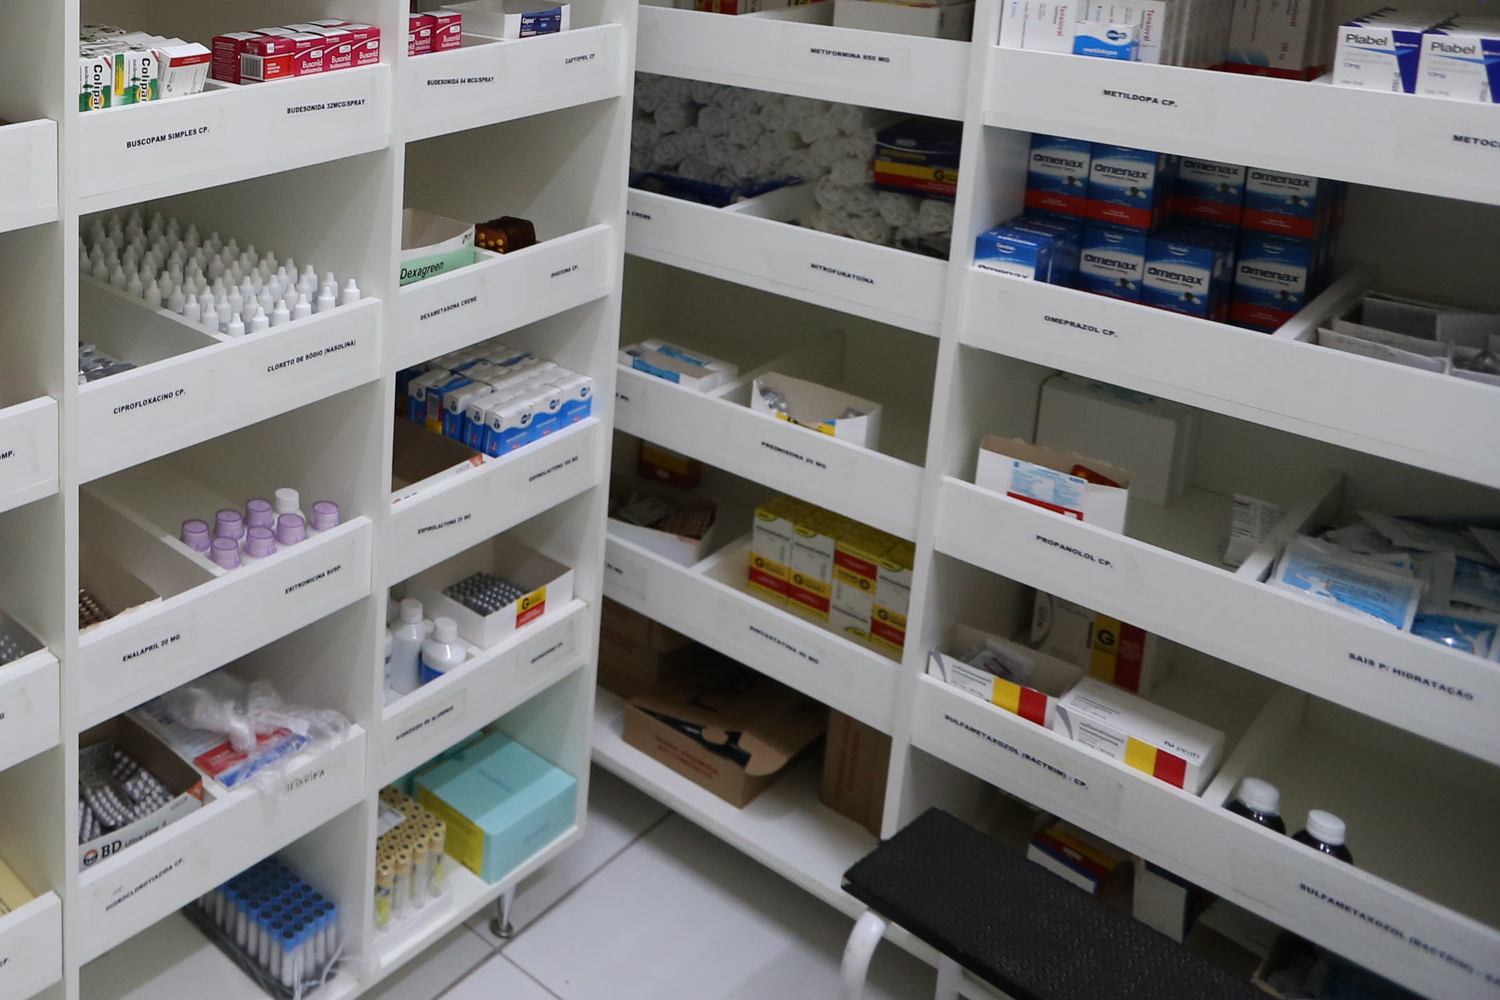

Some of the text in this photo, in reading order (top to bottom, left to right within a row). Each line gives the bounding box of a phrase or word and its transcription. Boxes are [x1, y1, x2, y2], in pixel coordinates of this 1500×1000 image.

[1346, 34, 1388, 46] Plabel
[1431, 42, 1476, 54] Plabel
[331, 55, 351, 66] Busonid
[810, 48, 861, 59] METIFORMINA
[427, 78, 459, 86] BUDESONIDA
[287, 103, 325, 114] BUDESONIDA
[1103, 88, 1178, 108] METILDOPA CP.
[126, 126, 209, 149] BUSCOPAM SIMPLES CP.
[400, 261, 444, 280] Dexagreen
[420, 296, 477, 320] DEXAMETASONA CREME
[1044, 315, 1118, 338] OMEPRAZOL CP.
[267, 339, 356, 373] CLORETO DE SÓDIO (NASOLINA)
[113, 391, 174, 415] CIPROFLOXACINO
[418, 518, 457, 535] ESPIROLACTONA
[1036, 533, 1114, 568] PROPANOLOL CP.
[284, 572, 326, 595] ERITROMICINA
[122, 634, 181, 662] ENALAPRIL 20 MG
[1348, 651, 1375, 667] SAIS
[1392, 665, 1474, 701] HIDRATAÇÃO
[944, 714, 1020, 756] SULFAMETAXOZOL
[1074, 778, 1088, 790] CP.
[101, 840, 122, 858] BD
[105, 863, 169, 911] HIDROCLOROTIAZIDA
[1300, 882, 1405, 940] SULFAMETAXOZOL
